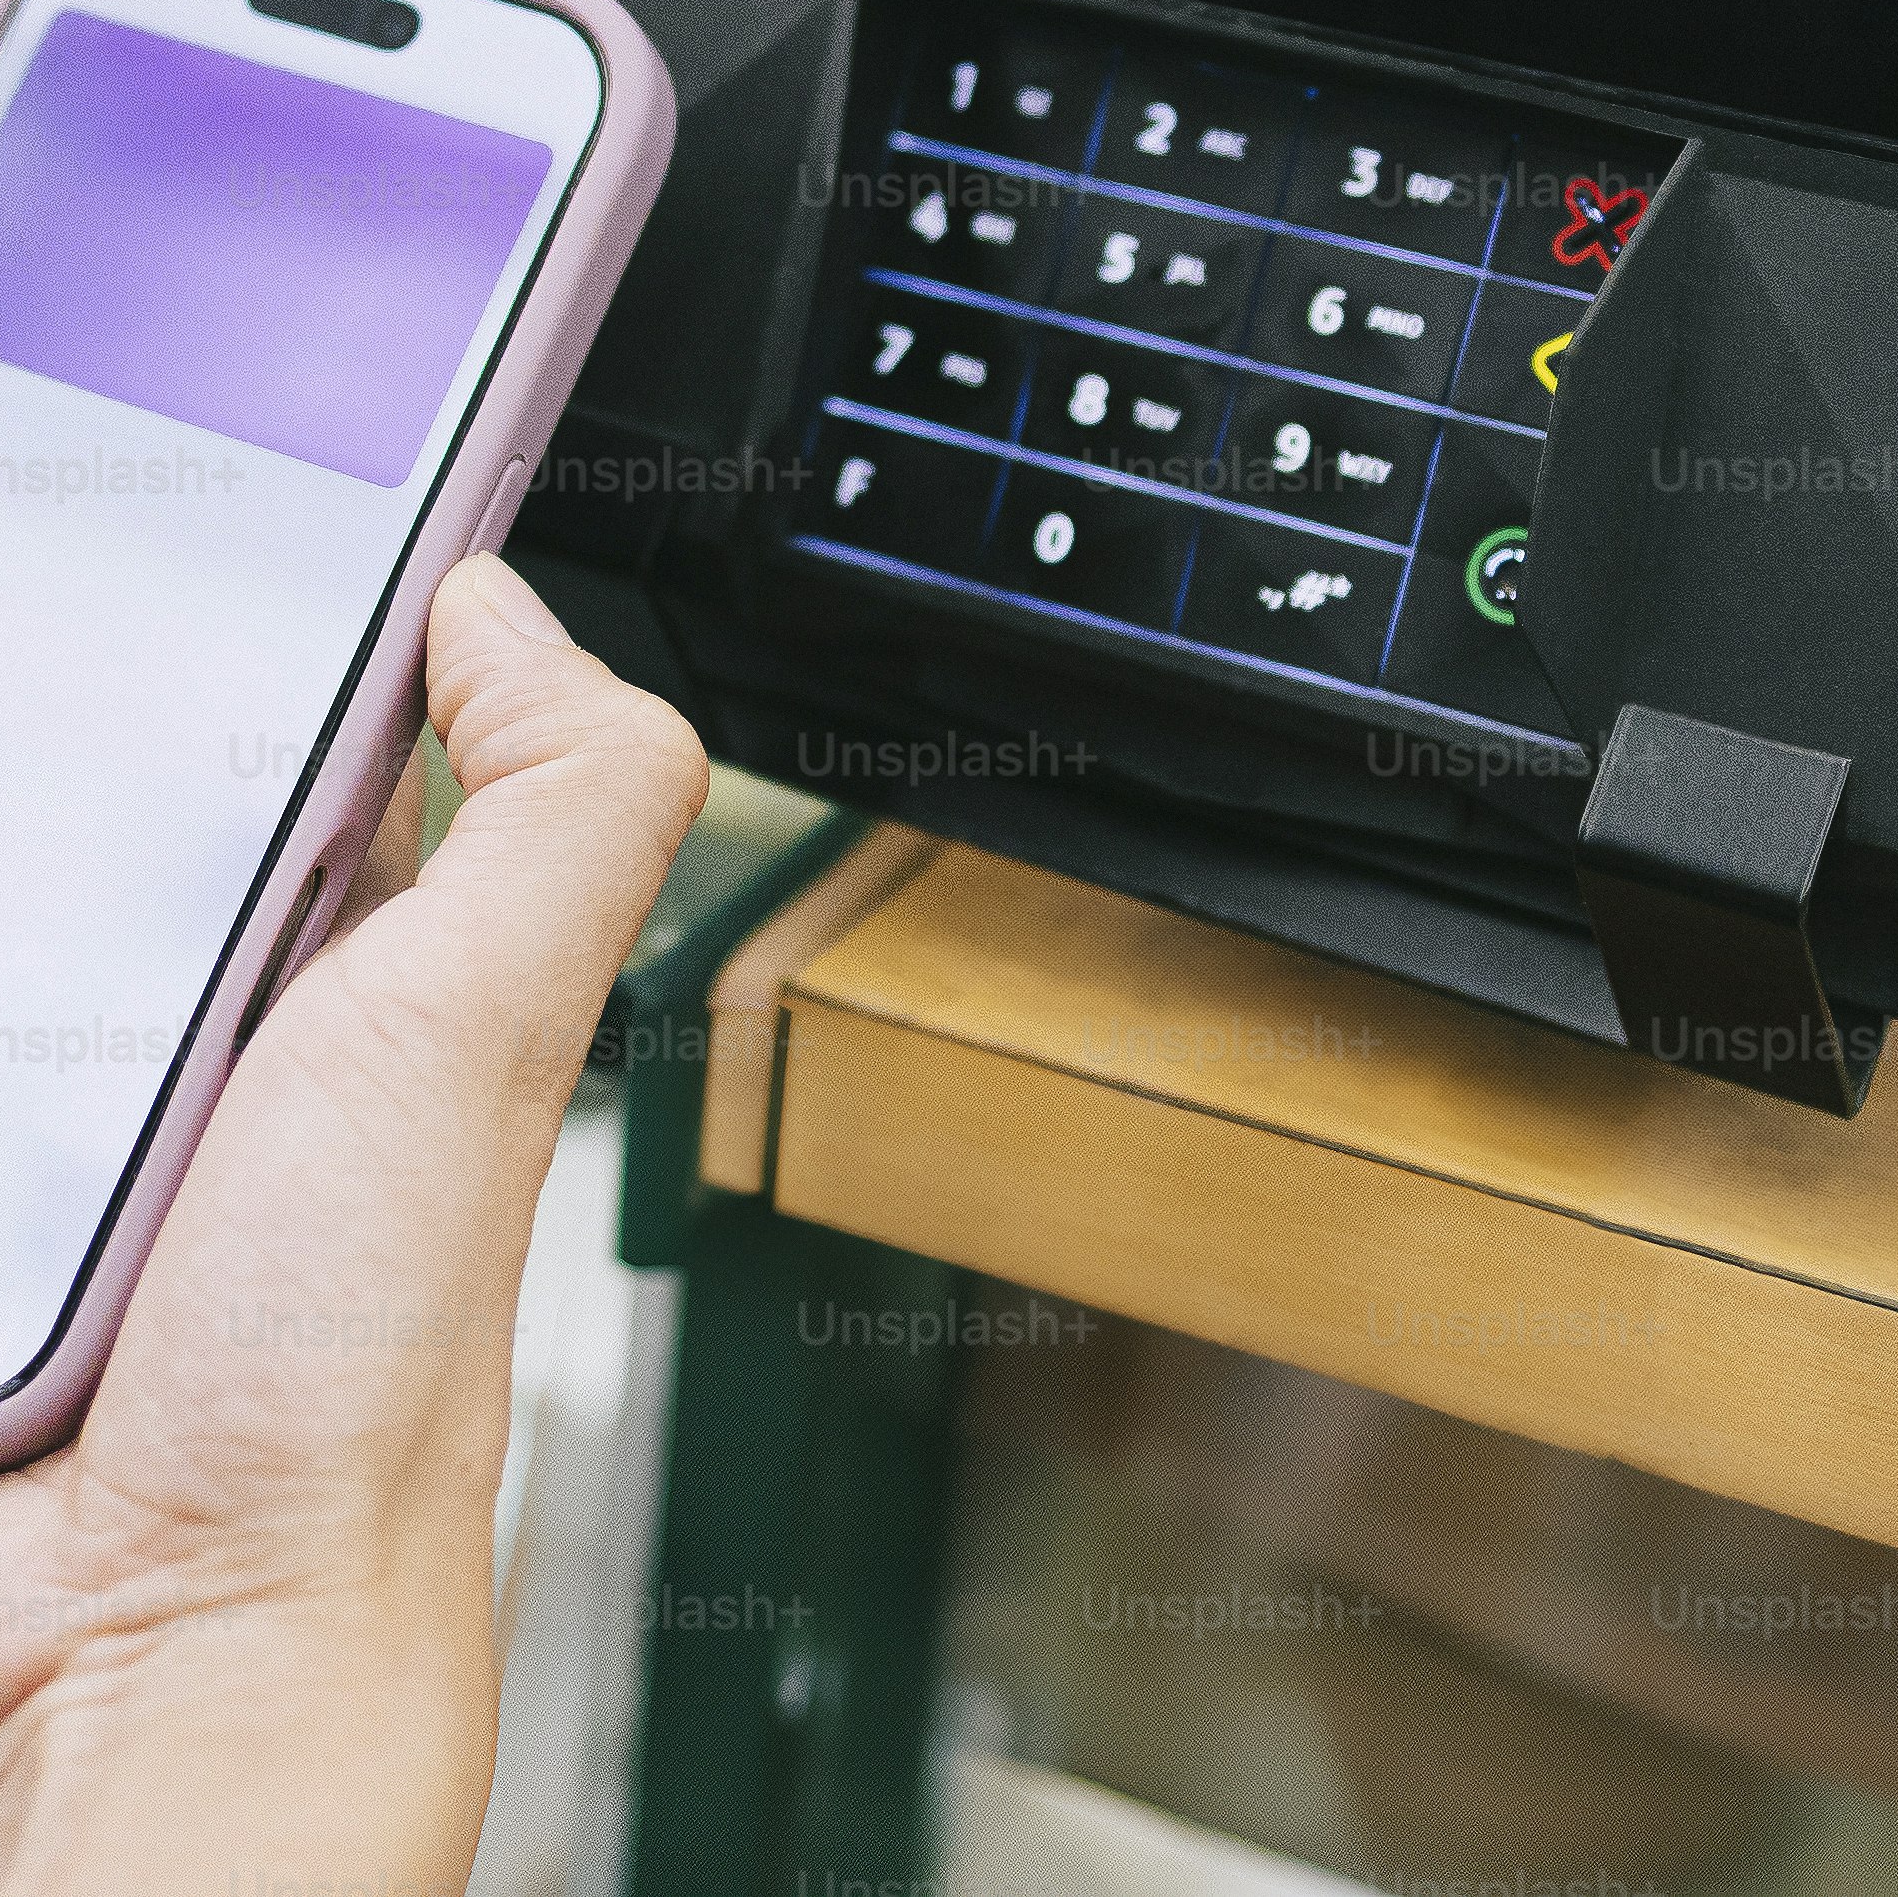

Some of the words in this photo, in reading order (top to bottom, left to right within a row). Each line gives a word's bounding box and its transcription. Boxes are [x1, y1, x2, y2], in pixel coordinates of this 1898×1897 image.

[950, 61, 980, 111] 1
[1135, 101, 1179, 158] 2
[1340, 145, 1384, 200] 3
[910, 192, 949, 243] 4
[1096, 230, 1142, 286] 5
[1306, 283, 1350, 338] 6
[875, 324, 915, 375] 7
[1066, 371, 1112, 428] 8
[1270, 420, 1314, 476] 9
[1032, 510, 1077, 566] 0
